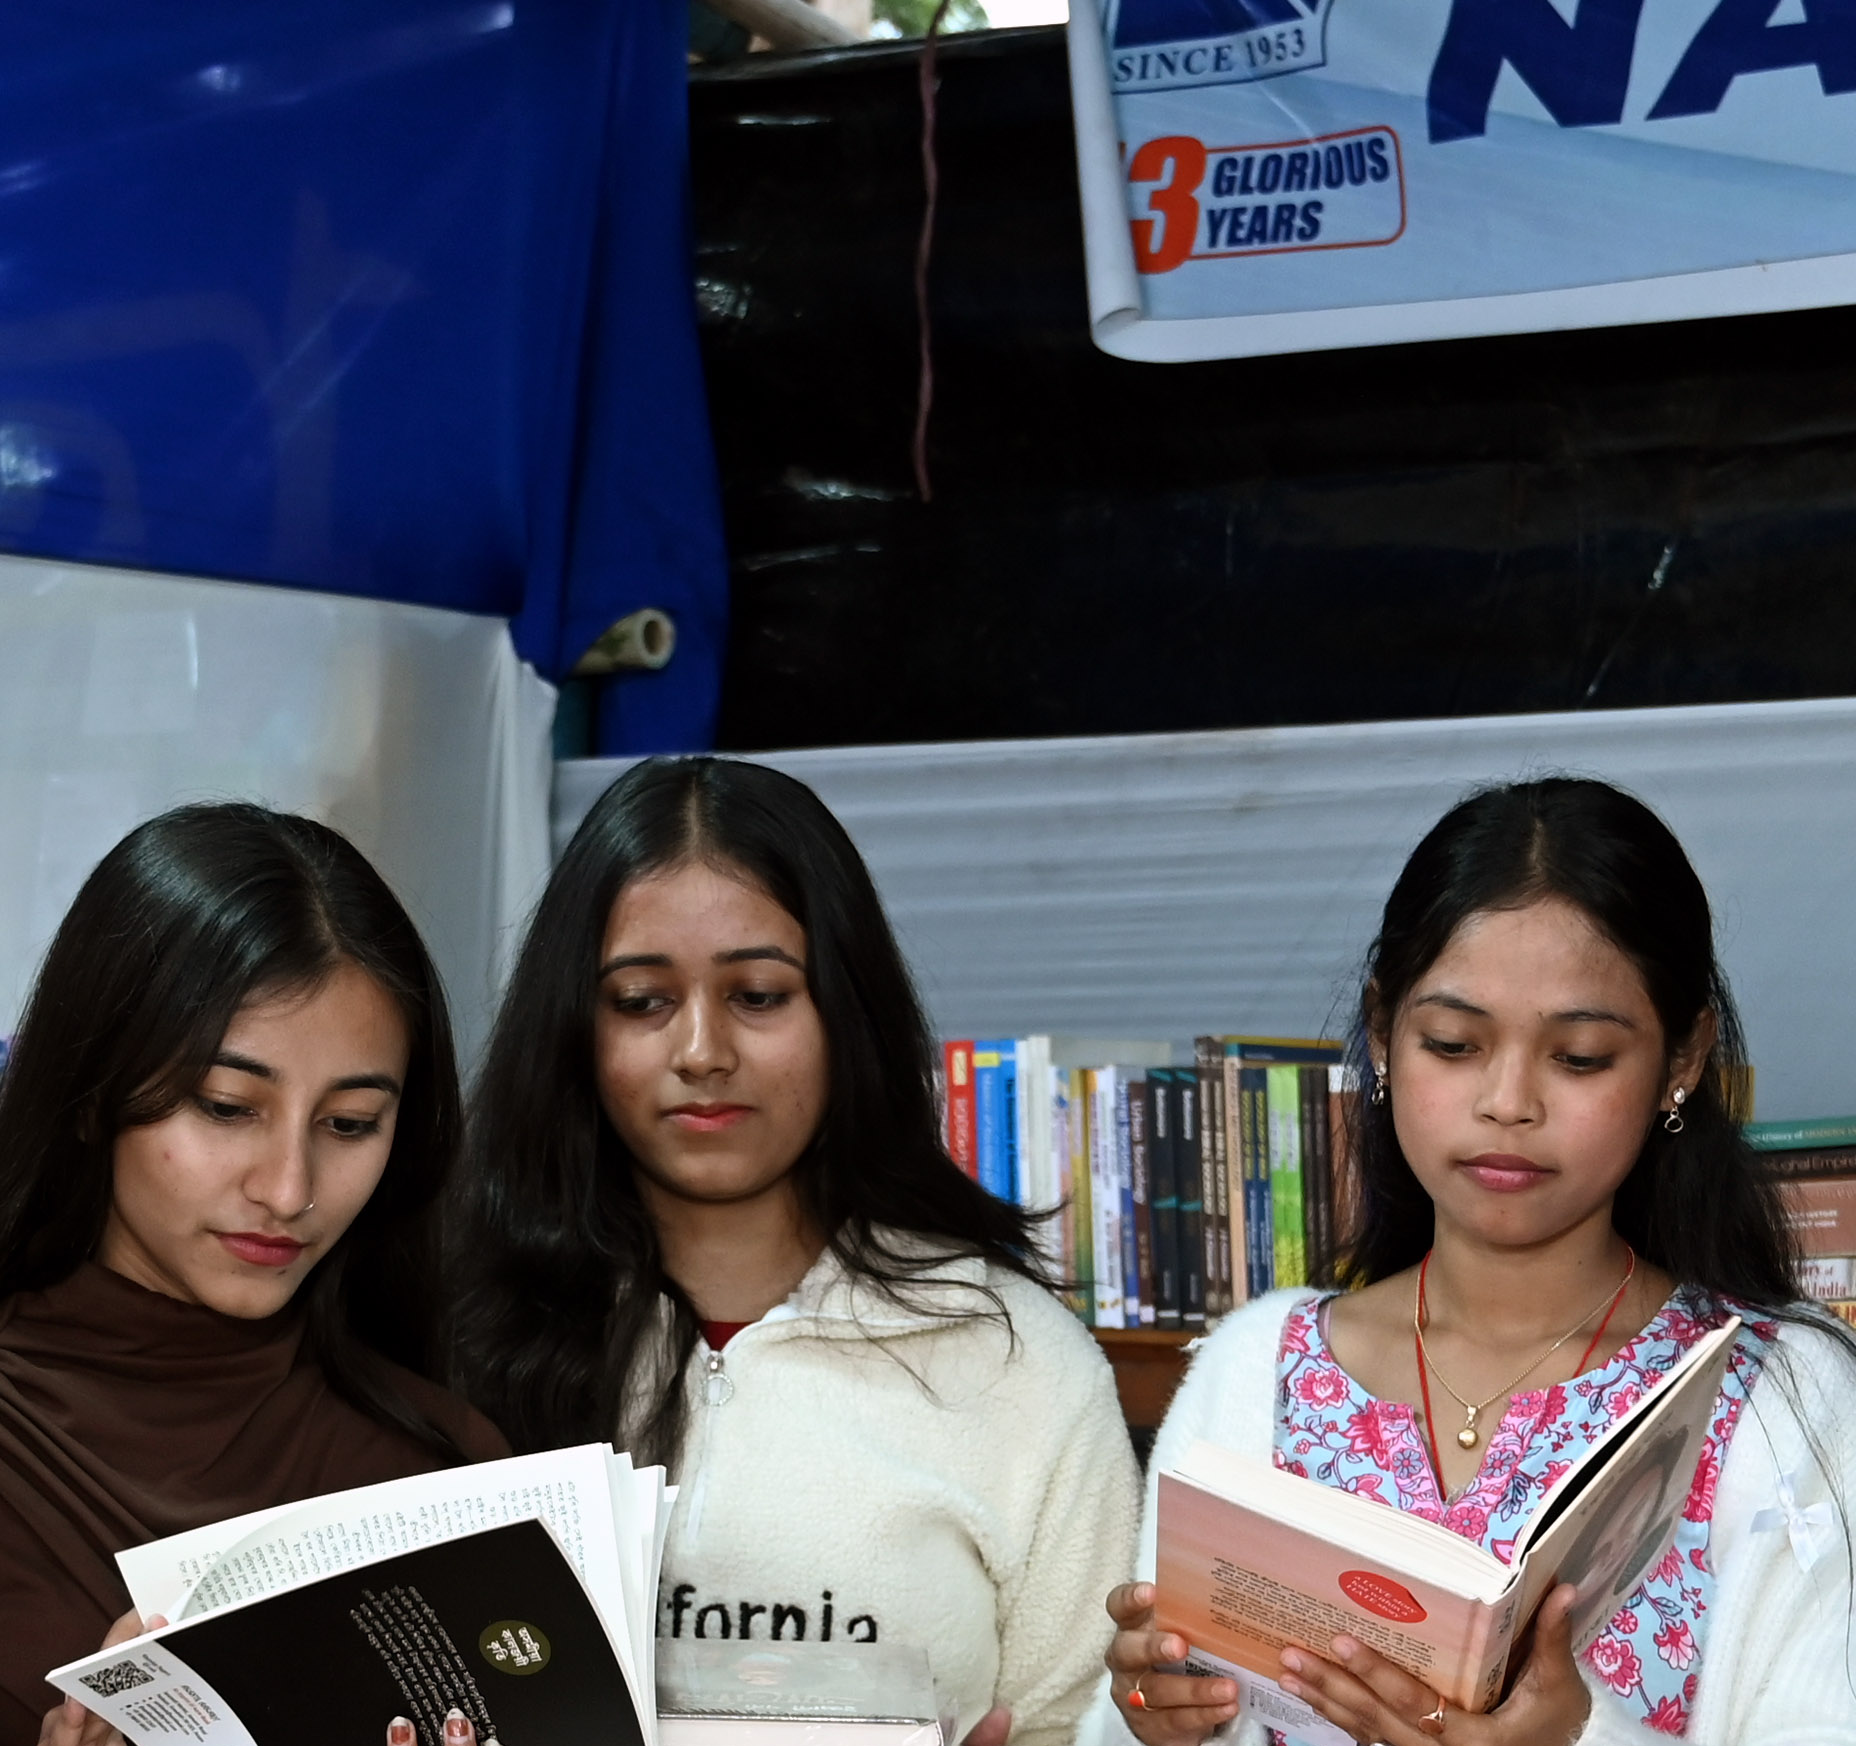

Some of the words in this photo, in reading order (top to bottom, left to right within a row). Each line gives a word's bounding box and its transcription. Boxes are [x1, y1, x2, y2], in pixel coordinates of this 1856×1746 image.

[1114, 48, 1235, 83] SINCE
[1244, 28, 1306, 67] 1953
[1211, 137, 1390, 197] GLORIOUS
[1116, 136, 1207, 274] 3
[1206, 202, 1323, 248] YEARS
[656, 1578, 879, 1643] fornia
